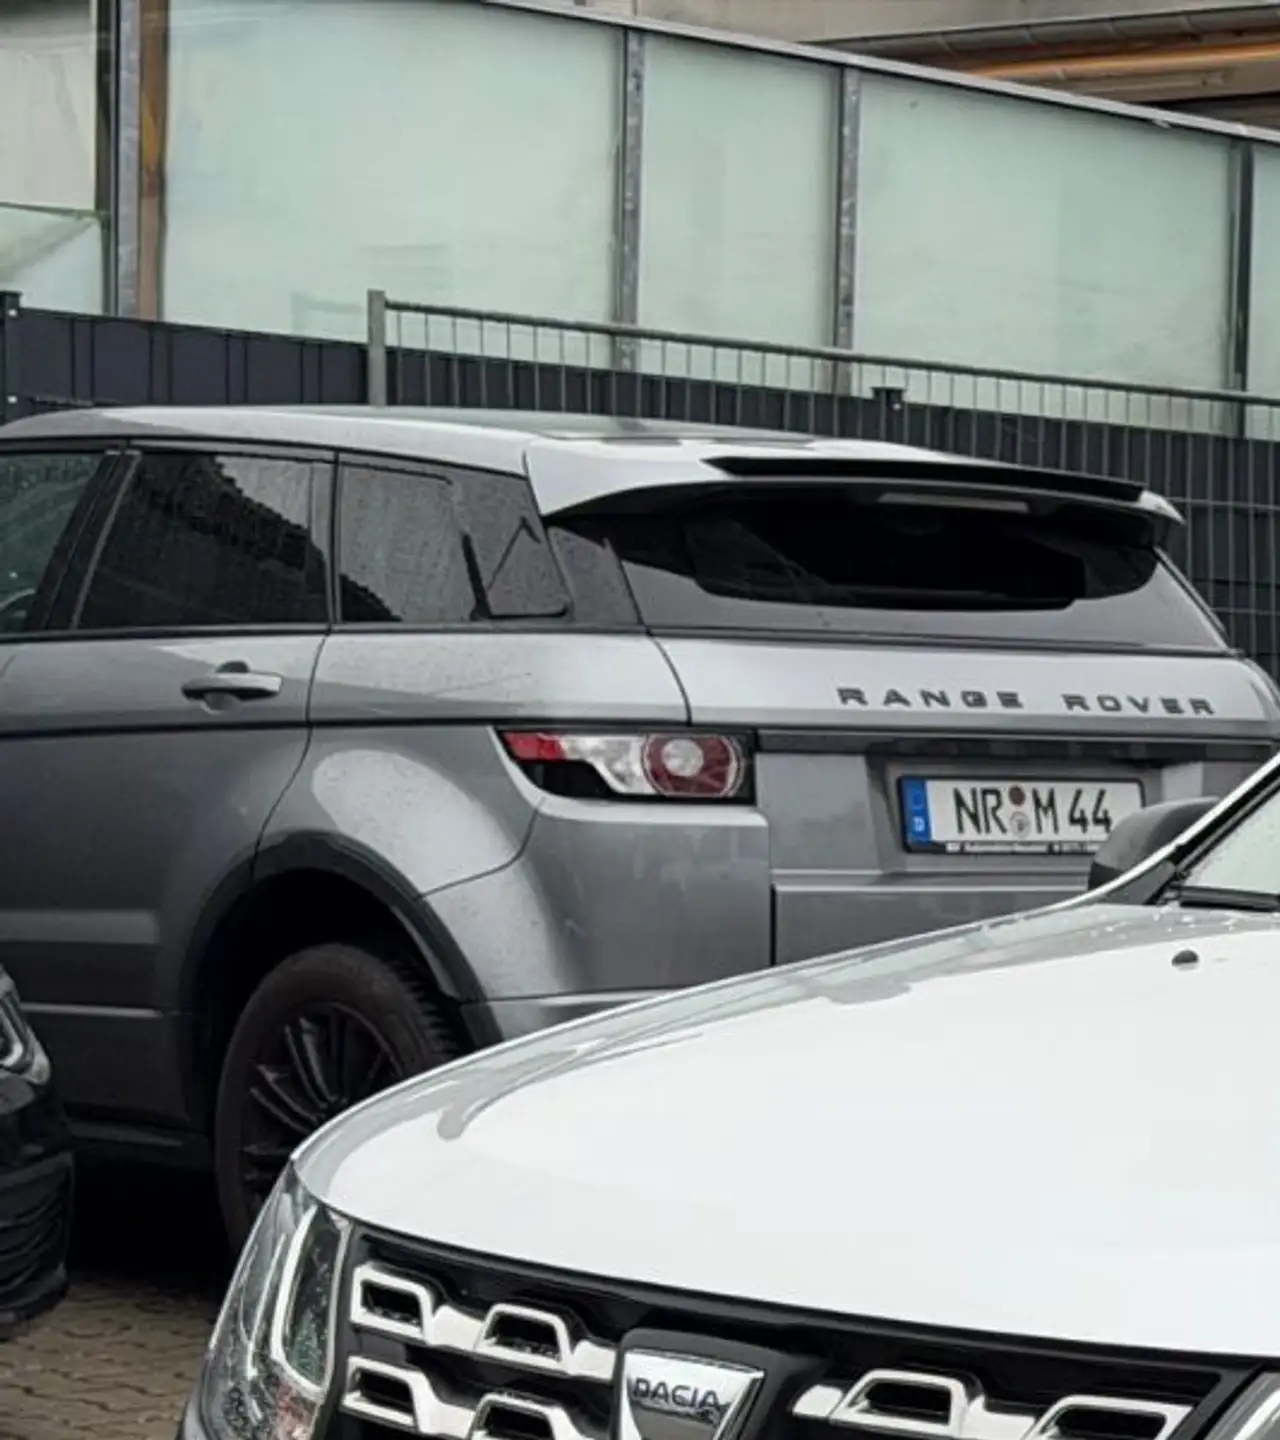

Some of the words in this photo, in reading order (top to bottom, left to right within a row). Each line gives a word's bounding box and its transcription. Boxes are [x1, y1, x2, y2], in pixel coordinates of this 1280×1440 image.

[836, 687, 1024, 709] RANGE
[1060, 693, 1215, 716] ROVER
[952, 786, 1008, 835] NR
[1031, 786, 1060, 834] M
[1068, 787, 1113, 834] 44
[632, 1377, 721, 1412] DACIA
